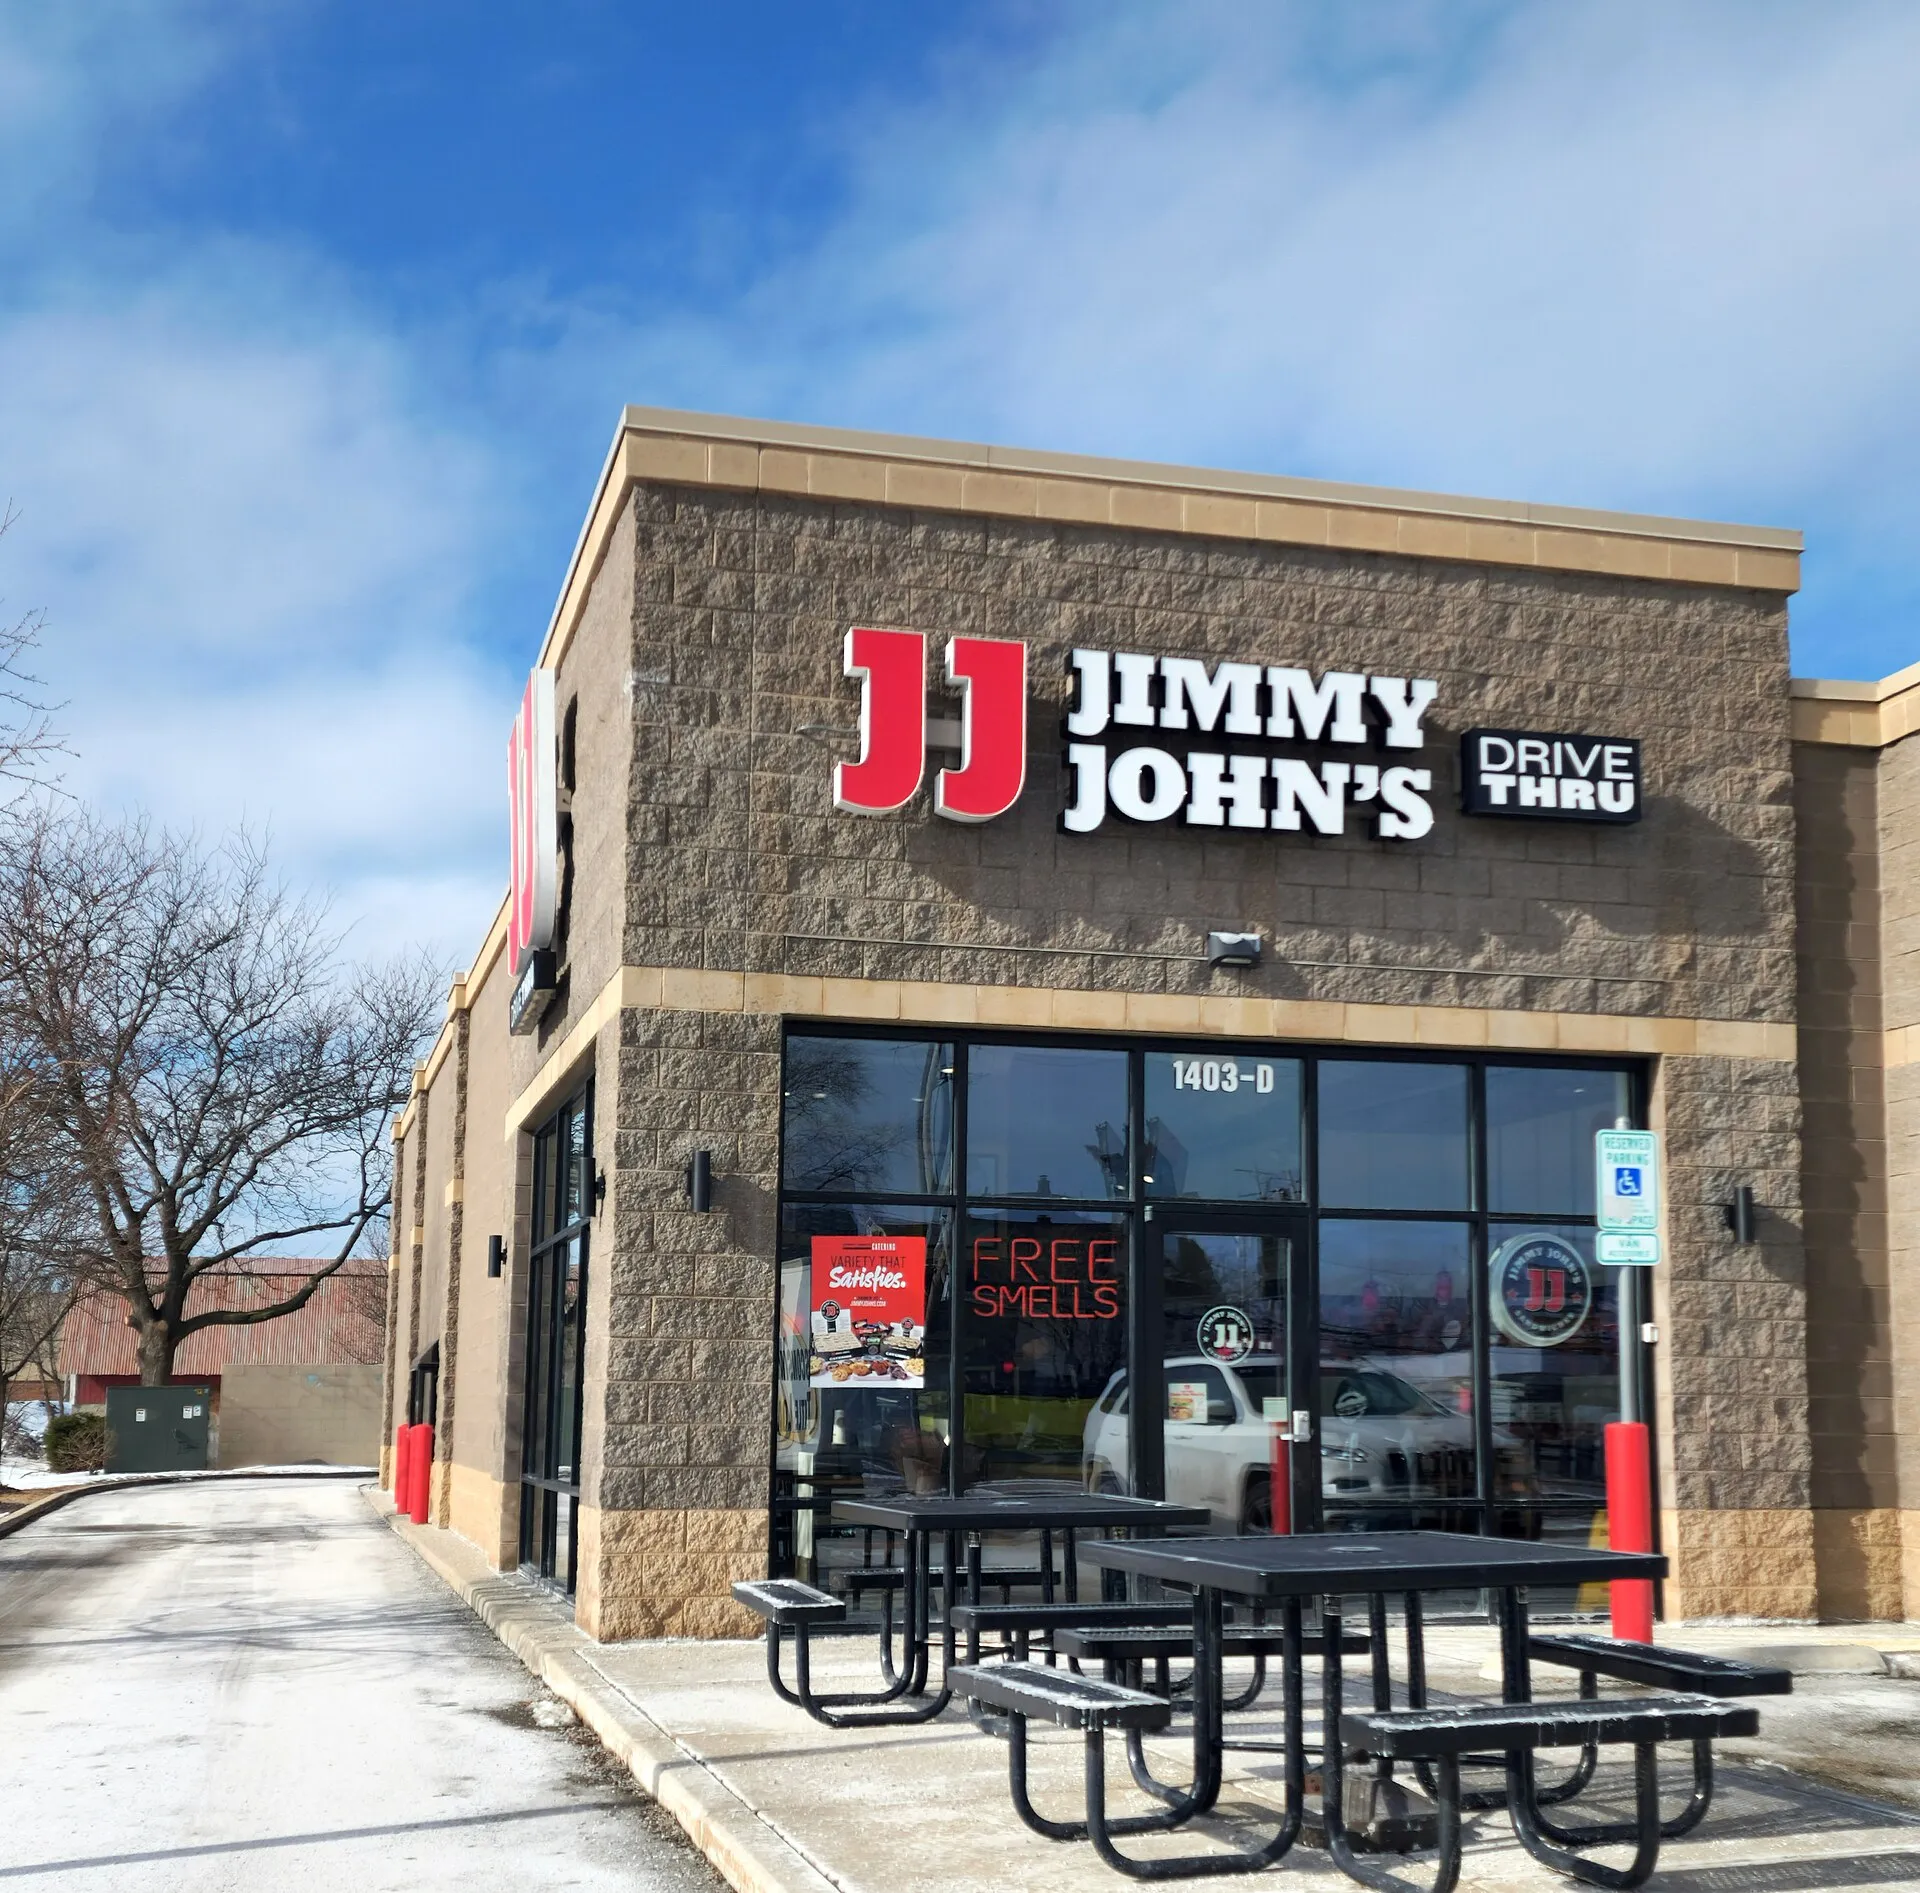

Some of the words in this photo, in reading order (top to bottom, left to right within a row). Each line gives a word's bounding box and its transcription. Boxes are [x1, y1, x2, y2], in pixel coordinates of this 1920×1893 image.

[1068, 648, 1437, 748] JIMMY
[834, 626, 1026, 823] JJ
[1479, 736, 1634, 780] DRIVE
[1064, 743, 1434, 839] JOHN'S
[1480, 773, 1635, 813] THRU
[1173, 1060, 1274, 1093] 1403-D
[1605, 1136, 1650, 1150] RESERVED
[1606, 1152, 1649, 1165] PARKING
[871, 1242, 896, 1251] CATERING
[974, 1237, 1118, 1283] FREE
[1618, 1239, 1640, 1248] VAN
[829, 1265, 906, 1293] Satisfies.
[830, 1255, 875, 1267] VARIETY
[879, 1256, 906, 1268] THAT
[1508, 1247, 1543, 1280] JIMMY
[1547, 1247, 1582, 1284] JOHN'S
[973, 1285, 1119, 1318] SMELLS
[1524, 1268, 1565, 1312] JJ
